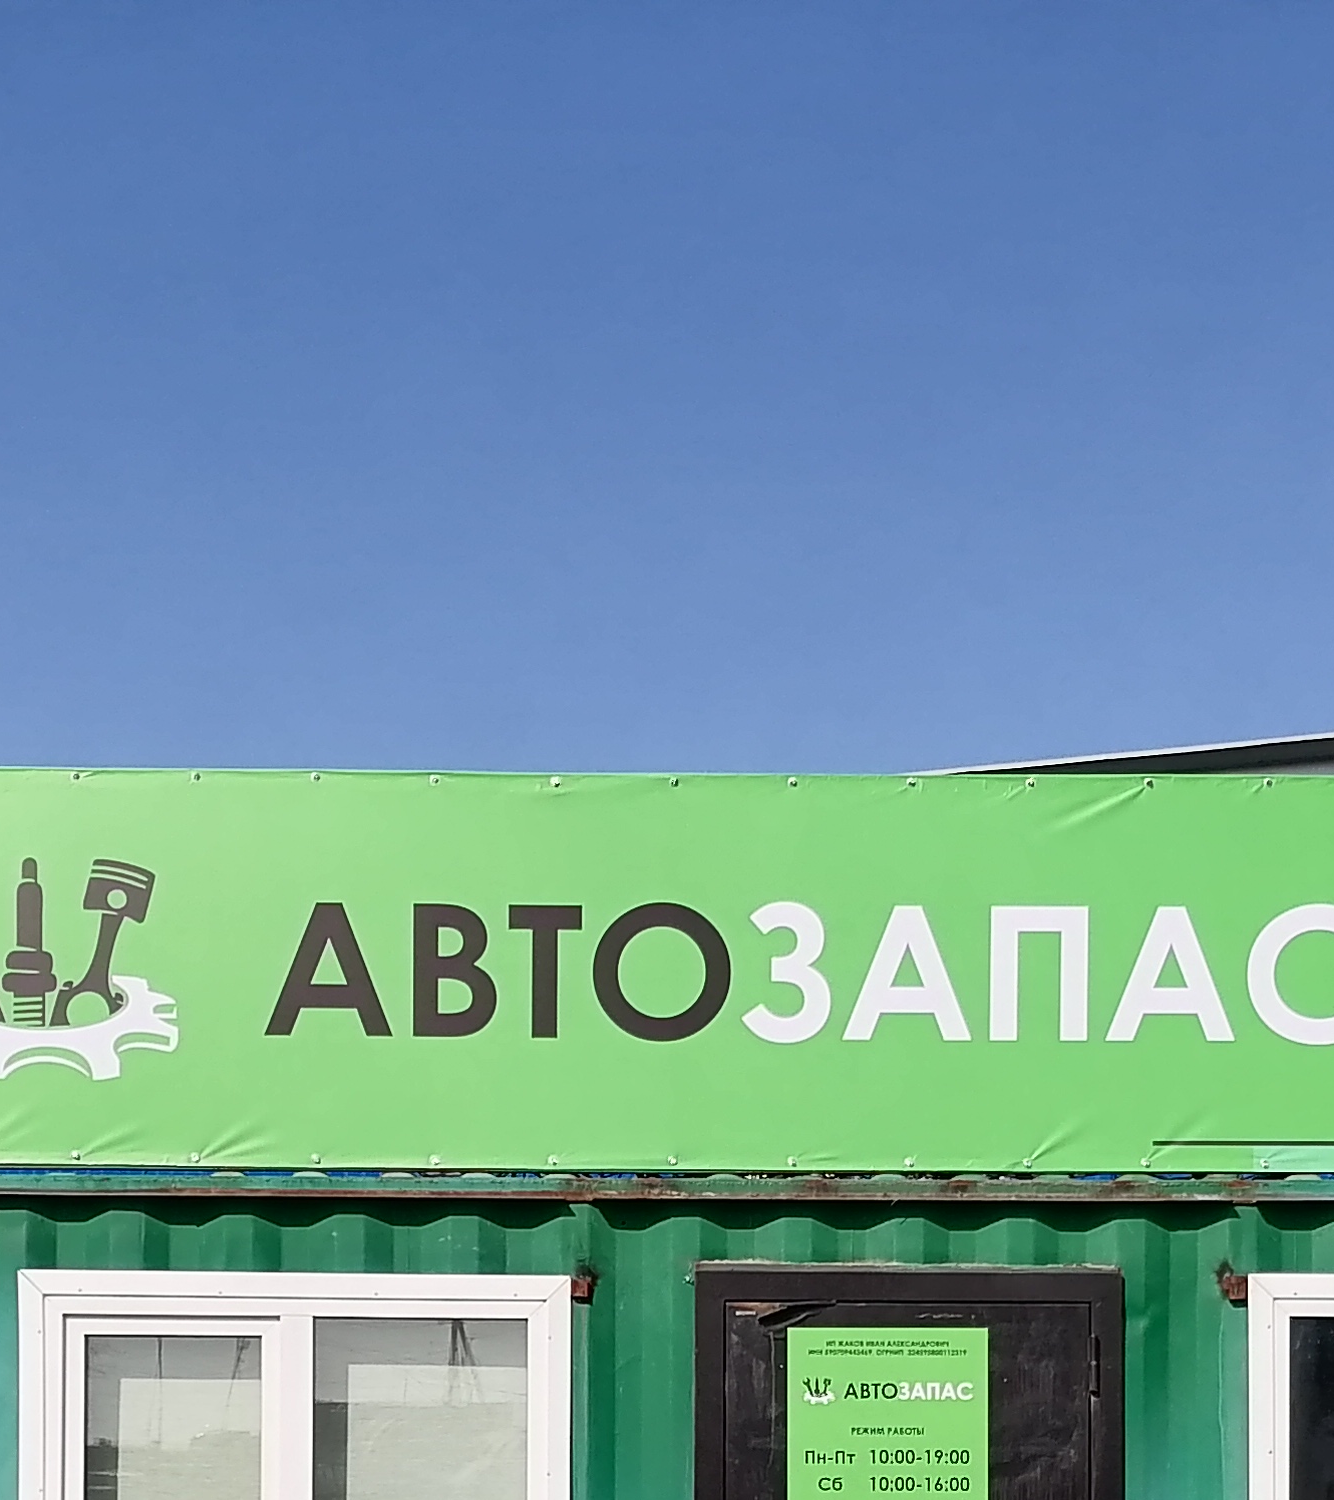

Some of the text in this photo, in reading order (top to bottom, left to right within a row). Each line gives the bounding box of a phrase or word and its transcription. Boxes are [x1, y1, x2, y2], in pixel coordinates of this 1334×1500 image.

[844, 1382, 974, 1401] АВТОЗАПАС
[851, 1426, 924, 1436] РЕЖИМ РАБОТЫ
[805, 1449, 970, 1464] Пн-Пт 10:00-19:00
[818, 1476, 970, 1492] Сб 10:00-16:00
